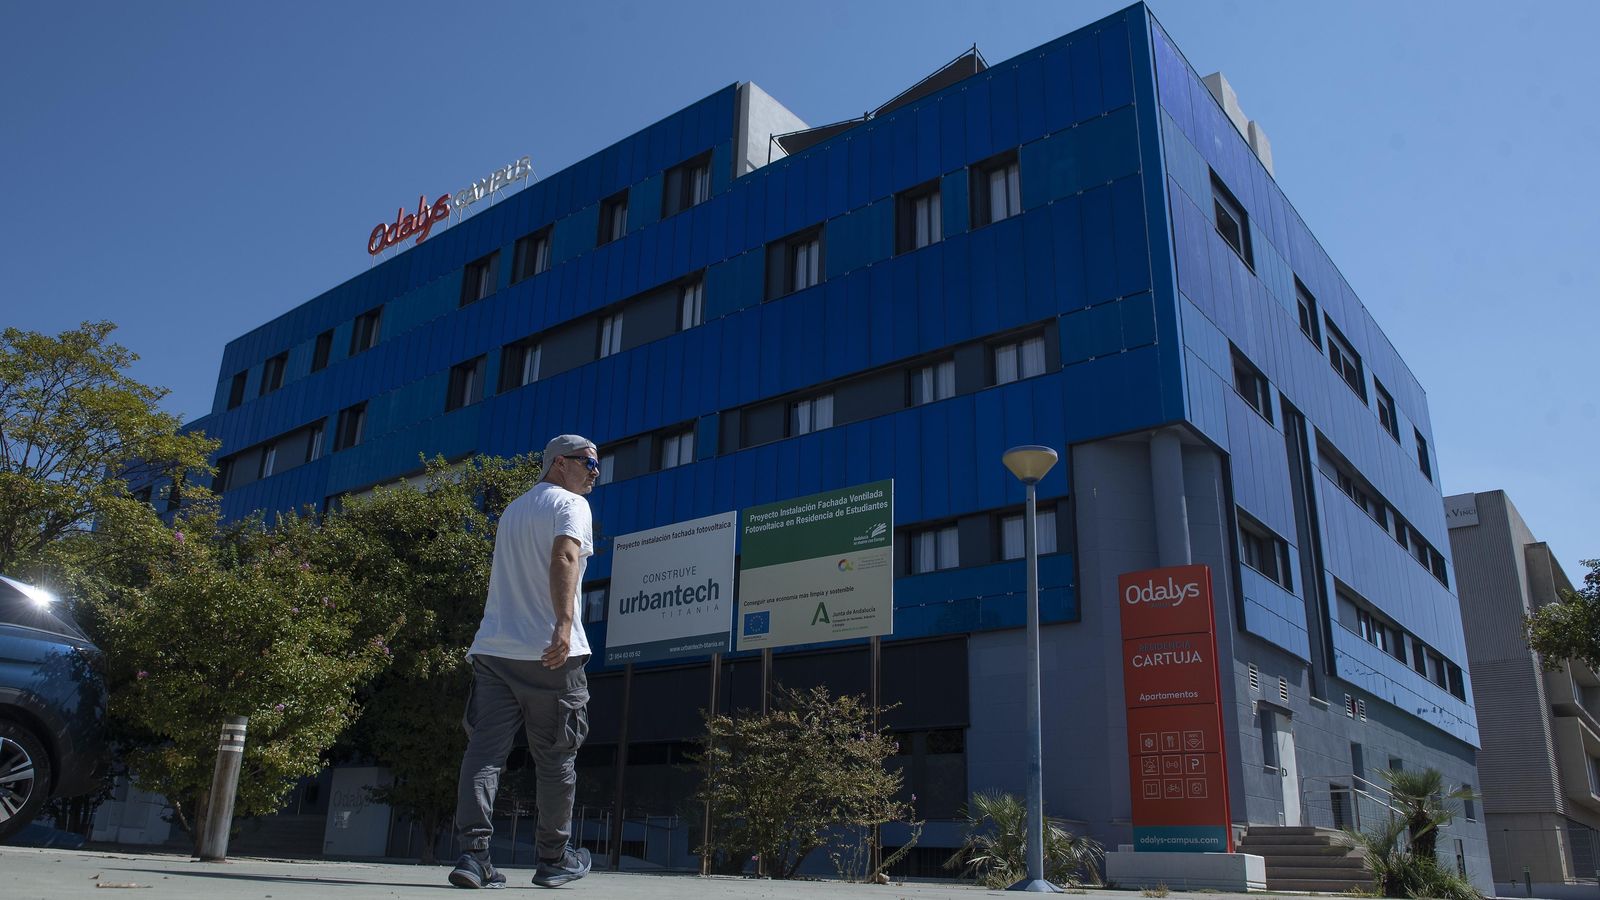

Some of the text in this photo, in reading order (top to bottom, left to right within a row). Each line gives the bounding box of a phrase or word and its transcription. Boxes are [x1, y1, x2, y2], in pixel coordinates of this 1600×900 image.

[367, 156, 532, 256] Odalys CAMPUS
[745, 522, 784, 534] Fotovoltaica
[796, 512, 833, 524] Residencia
[835, 509, 844, 517] de
[846, 500, 888, 515] Estudiantes
[750, 490, 883, 522] Proyecto Instalación Fachada Ventilada
[616, 521, 731, 551] Proyecto instalación fachada fotovoltaica
[642, 566, 697, 584] CONSTRUYE
[619, 578, 720, 615] urbantech
[744, 598, 766, 607] Conseguir
[810, 590, 824, 598] limpia
[830, 586, 854, 594] sostenible
[1125, 577, 1200, 606] Odalys
[662, 604, 719, 618] TITANIA
[1132, 651, 1202, 667] CARTUJA
[1140, 691, 1198, 701] Apartamentos
[1140, 835, 1218, 846] odalys-campus.com
